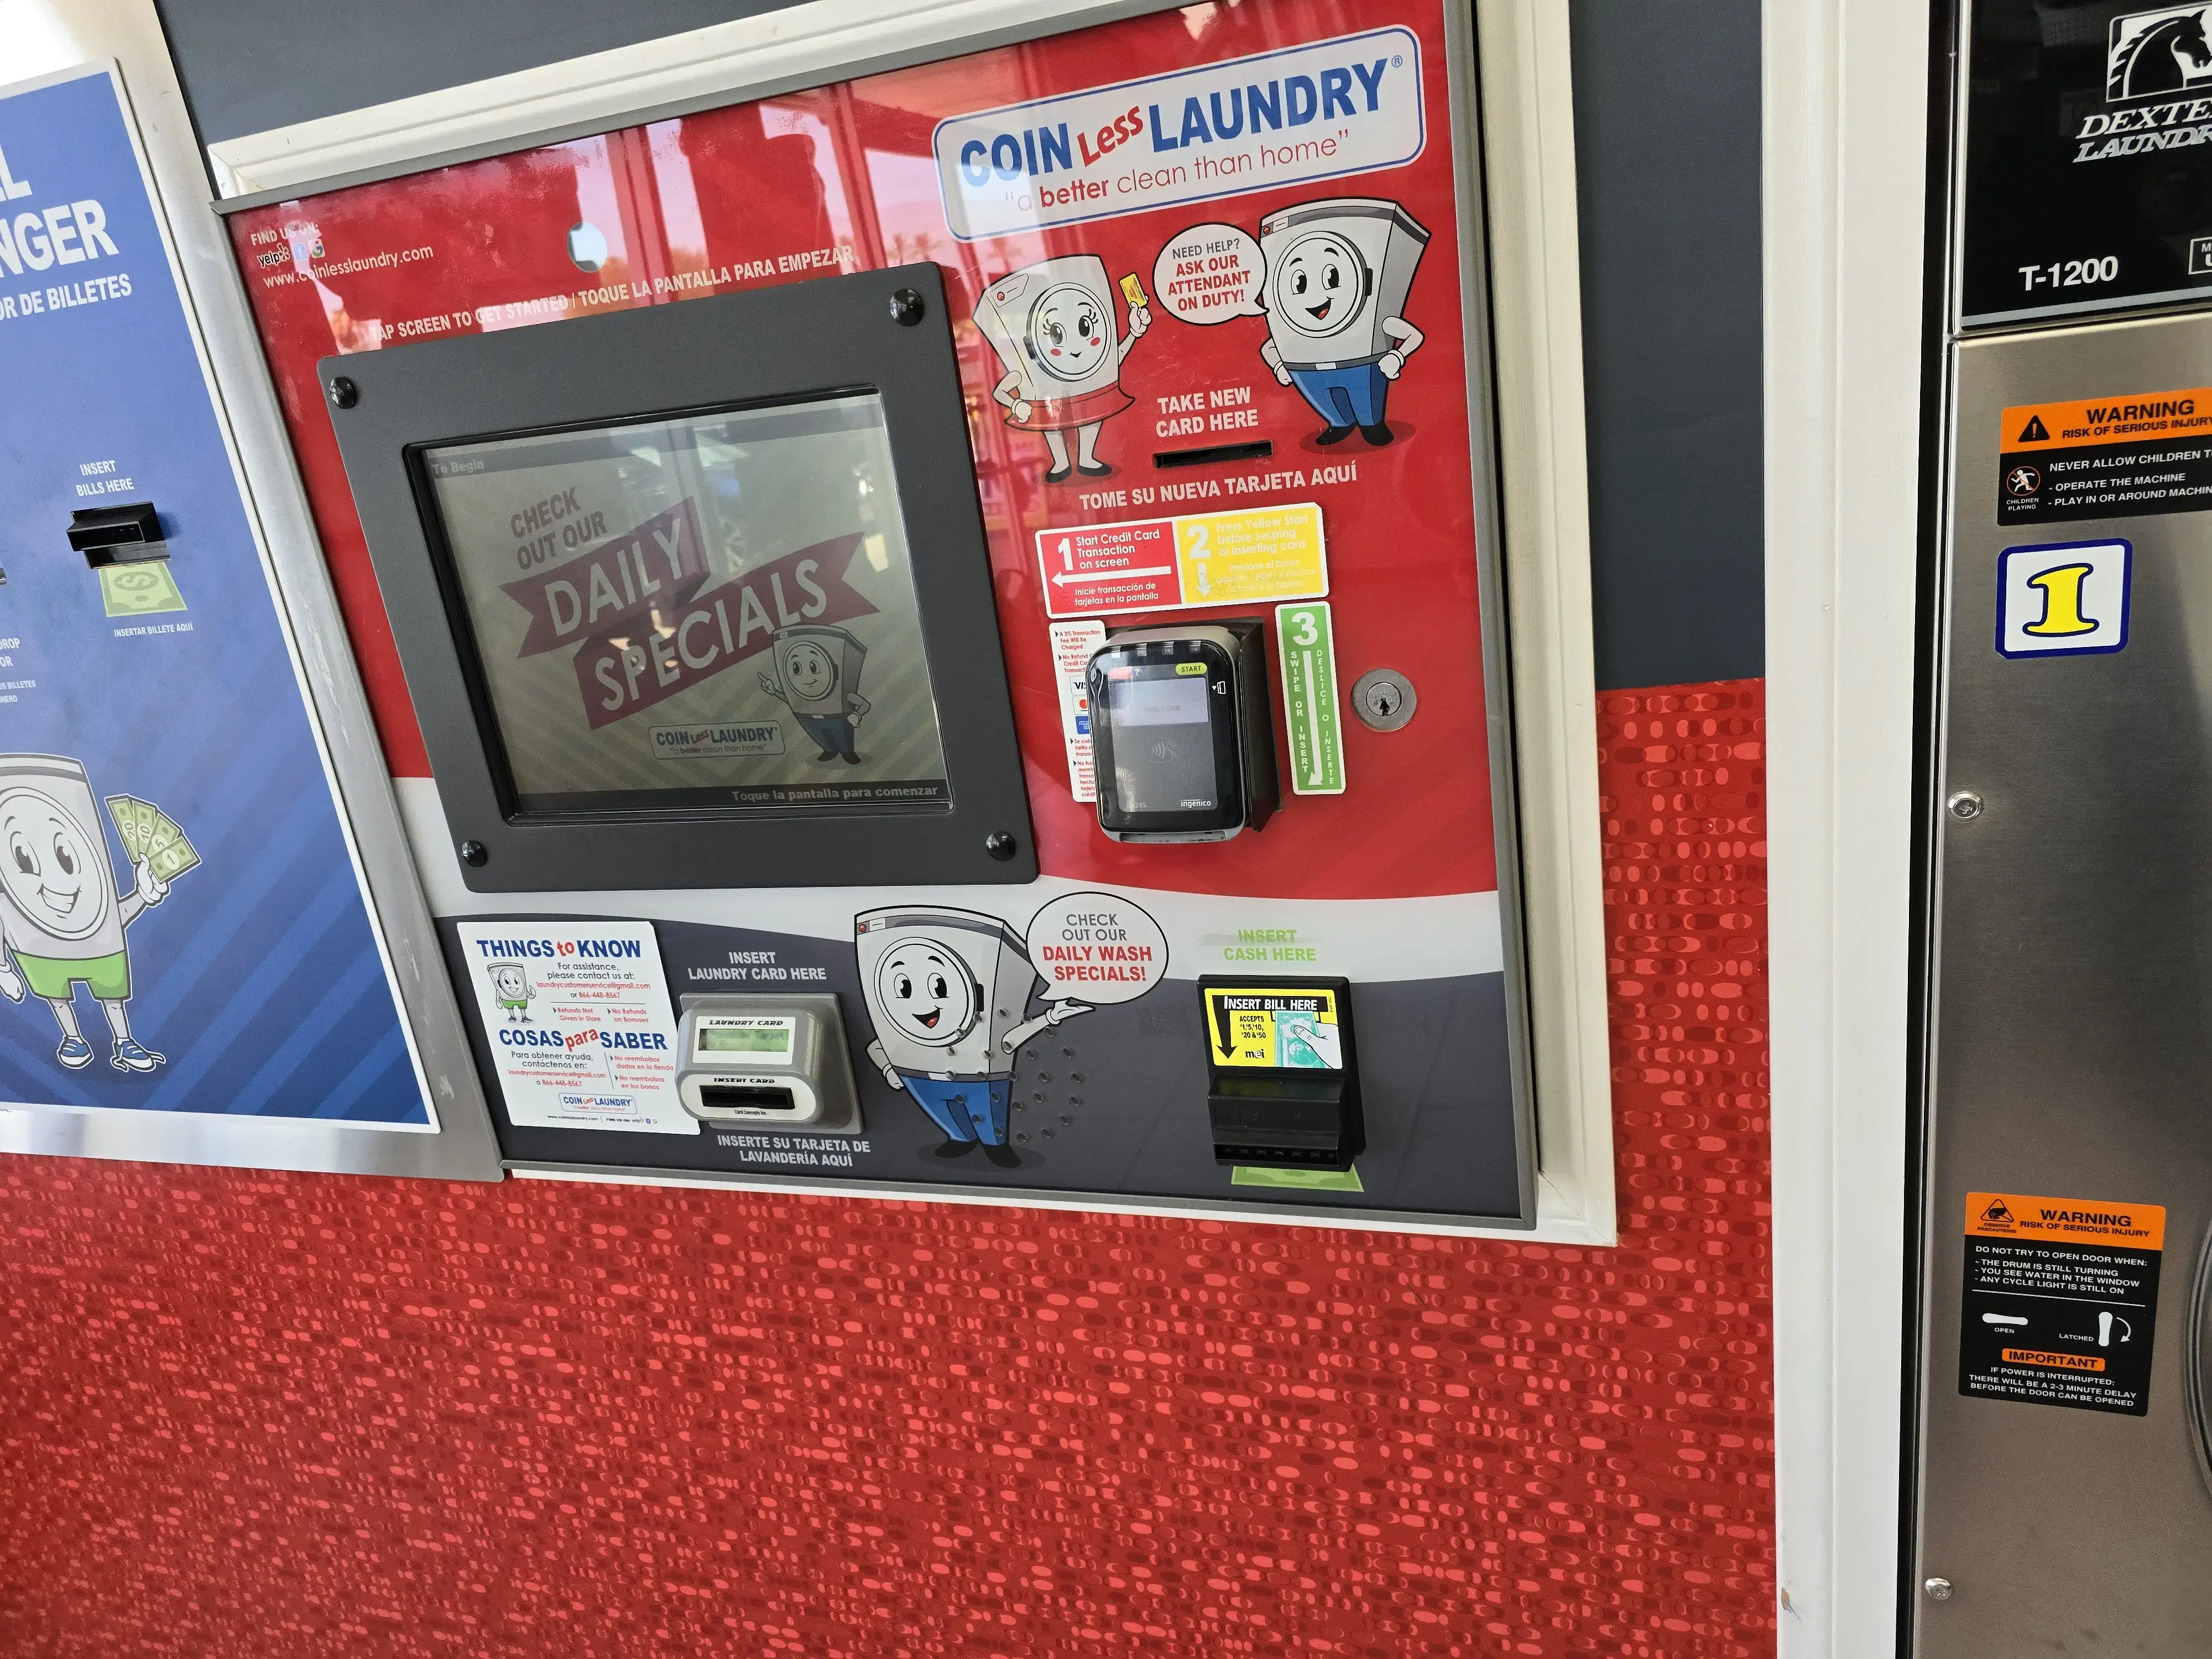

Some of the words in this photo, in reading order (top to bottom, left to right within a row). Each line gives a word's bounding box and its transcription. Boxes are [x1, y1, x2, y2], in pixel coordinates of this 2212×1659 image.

[960, 122, 1072, 187] COIN
[1077, 106, 1145, 168] Less
[1039, 177, 1110, 208] better
[1117, 161, 1187, 194] clean
[1194, 153, 1251, 180] than
[251, 231, 277, 246] FIND
[280, 227, 296, 239] US
[1172, 244, 1202, 259] NEED
[1206, 238, 1240, 254] HELP?
[257, 251, 280, 269] yelp
[263, 246, 434, 288] www.coinlesslaundry.com
[1176, 259, 1204, 276] ASK
[1208, 254, 1239, 271] OUR
[2018, 255, 2119, 291] T-1200
[399, 315, 451, 337] SCREEN
[452, 311, 472, 328] TO
[475, 304, 502, 325] GET
[505, 294, 568, 319] STARTED
[578, 285, 630, 307] TOQUE
[632, 281, 653, 298] LA
[655, 267, 732, 294] PANTALLA
[734, 259, 776, 281] PARA
[778, 245, 855, 274] EMPEZAR
[1168, 270, 1251, 296] ATTENDANT
[19, 290, 45, 316] DE
[46, 273, 132, 311] BILLETES
[1177, 296, 1198, 311] ON
[1202, 289, 1244, 308] DUTY!
[1157, 392, 1206, 415] TAKE
[1210, 386, 1251, 408] NEW
[2086, 399, 2195, 425] WARNING
[1156, 416, 1204, 438] CARD
[1209, 409, 1259, 431] HERE
[2062, 427, 2090, 439] RISK
[2094, 426, 2111, 436] OF
[2113, 420, 2168, 434] SERIOUS
[80, 460, 117, 476] INSERT
[2049, 460, 2090, 472] NEVER
[2093, 456, 2137, 468] ALLOW
[2138, 450, 2201, 465] CHILDREN
[76, 481, 105, 497] BILLS
[106, 477, 135, 493] HERE
[1079, 490, 1128, 511] TOME
[1131, 487, 1155, 505] SU
[1160, 480, 1220, 503] NUEVA
[1224, 470, 1306, 495] TARJETA
[1311, 460, 1357, 486] AQUÍ
[2055, 479, 2107, 492] OPERATE
[2110, 477, 2132, 487] THE
[2135, 472, 2187, 486] MACHINE
[2006, 497, 2039, 505] CHILDREN
[2054, 495, 2083, 507] PLAY
[2085, 494, 2096, 504] IN
[2099, 492, 2116, 503] OR
[2117, 488, 2166, 502] AROUND
[510, 486, 581, 539] CHECK
[517, 533, 556, 570] OUT
[562, 510, 608, 549] OUR
[1076, 536, 1098, 547] Start
[1100, 532, 1132, 544] Credit
[1134, 529, 1161, 541] Card
[1187, 525, 1212, 560] 2
[1057, 538, 1074, 571] 1
[1077, 545, 1135, 559] Transaction
[1079, 561, 1093, 570] on
[1095, 557, 1129, 568] screen
[544, 516, 685, 638] DAILY
[2022, 562, 2100, 638] 1
[113, 625, 147, 638] INSERTAR
[148, 623, 175, 635] BILLETE
[176, 620, 194, 633] AQUÍ
[592, 557, 828, 712] SPECIALS
[1292, 612, 1318, 646] 3
[731, 790, 770, 803] Toque
[774, 790, 785, 800] la
[788, 788, 839, 802] pantalla
[843, 789, 872, 800] para
[875, 786, 938, 797] comenzar
[1181, 799, 1212, 808] ingenico
[1065, 913, 1119, 927] CHECK
[1061, 928, 1092, 942] OUT
[1095, 928, 1128, 942] OUR
[1237, 929, 1297, 943] INSERT
[476, 940, 555, 958] THINGS
[556, 941, 575, 957] to
[576, 940, 641, 958] KNOW
[728, 952, 776, 964] INSERT
[1042, 946, 1093, 962] DAILY
[1099, 945, 1152, 962] WASH
[1223, 947, 1267, 962] CASH
[1272, 947, 1317, 962] HERE
[547, 971, 576, 980] please
[577, 972, 610, 980] contact
[557, 962, 571, 971] For
[572, 962, 619, 972] assistance,
[687, 968, 747, 980] LAUNDRY
[751, 968, 787, 980] CARD
[790, 968, 827, 980] HERE
[1054, 966, 1146, 982] SPECIALS!
[536, 981, 651, 990] laundrycustomerservice@gmail.com
[1223, 995, 1261, 1010] INSERT
[1264, 999, 1287, 1011] BILL
[1290, 999, 1317, 1011] HERE
[499, 1029, 564, 1047] COSAS
[565, 1028, 599, 1052] para
[599, 1031, 669, 1050] SABER
[1245, 1048, 1265, 1059] mei
[717, 1135, 770, 1149] INSERTE
[773, 1137, 791, 1150] SU
[792, 1138, 851, 1152] TARJETA
[853, 1141, 871, 1153] DE
[739, 1150, 818, 1165] LAVANDERÍA
[821, 1152, 853, 1168] AQUÍ
[2039, 1208, 2132, 1228] WARNING
[2019, 1220, 2043, 1229] RISK
[2046, 1222, 2060, 1230] OF
[2063, 1223, 2109, 1234] SERIOUS
[2111, 1227, 2151, 1238] INJURY
[1975, 1245, 1990, 1254] DO
[1992, 1246, 2013, 1255] NOT
[2014, 1248, 2034, 1258] TRY
[2036, 1249, 2050, 1258] TO
[2052, 1251, 2080, 1261] OPEN
[2081, 1254, 2112, 1264] DOOR
[2114, 1256, 2148, 1267] WHEN:
[2008, 1350, 2099, 1370] IMPORTANT
